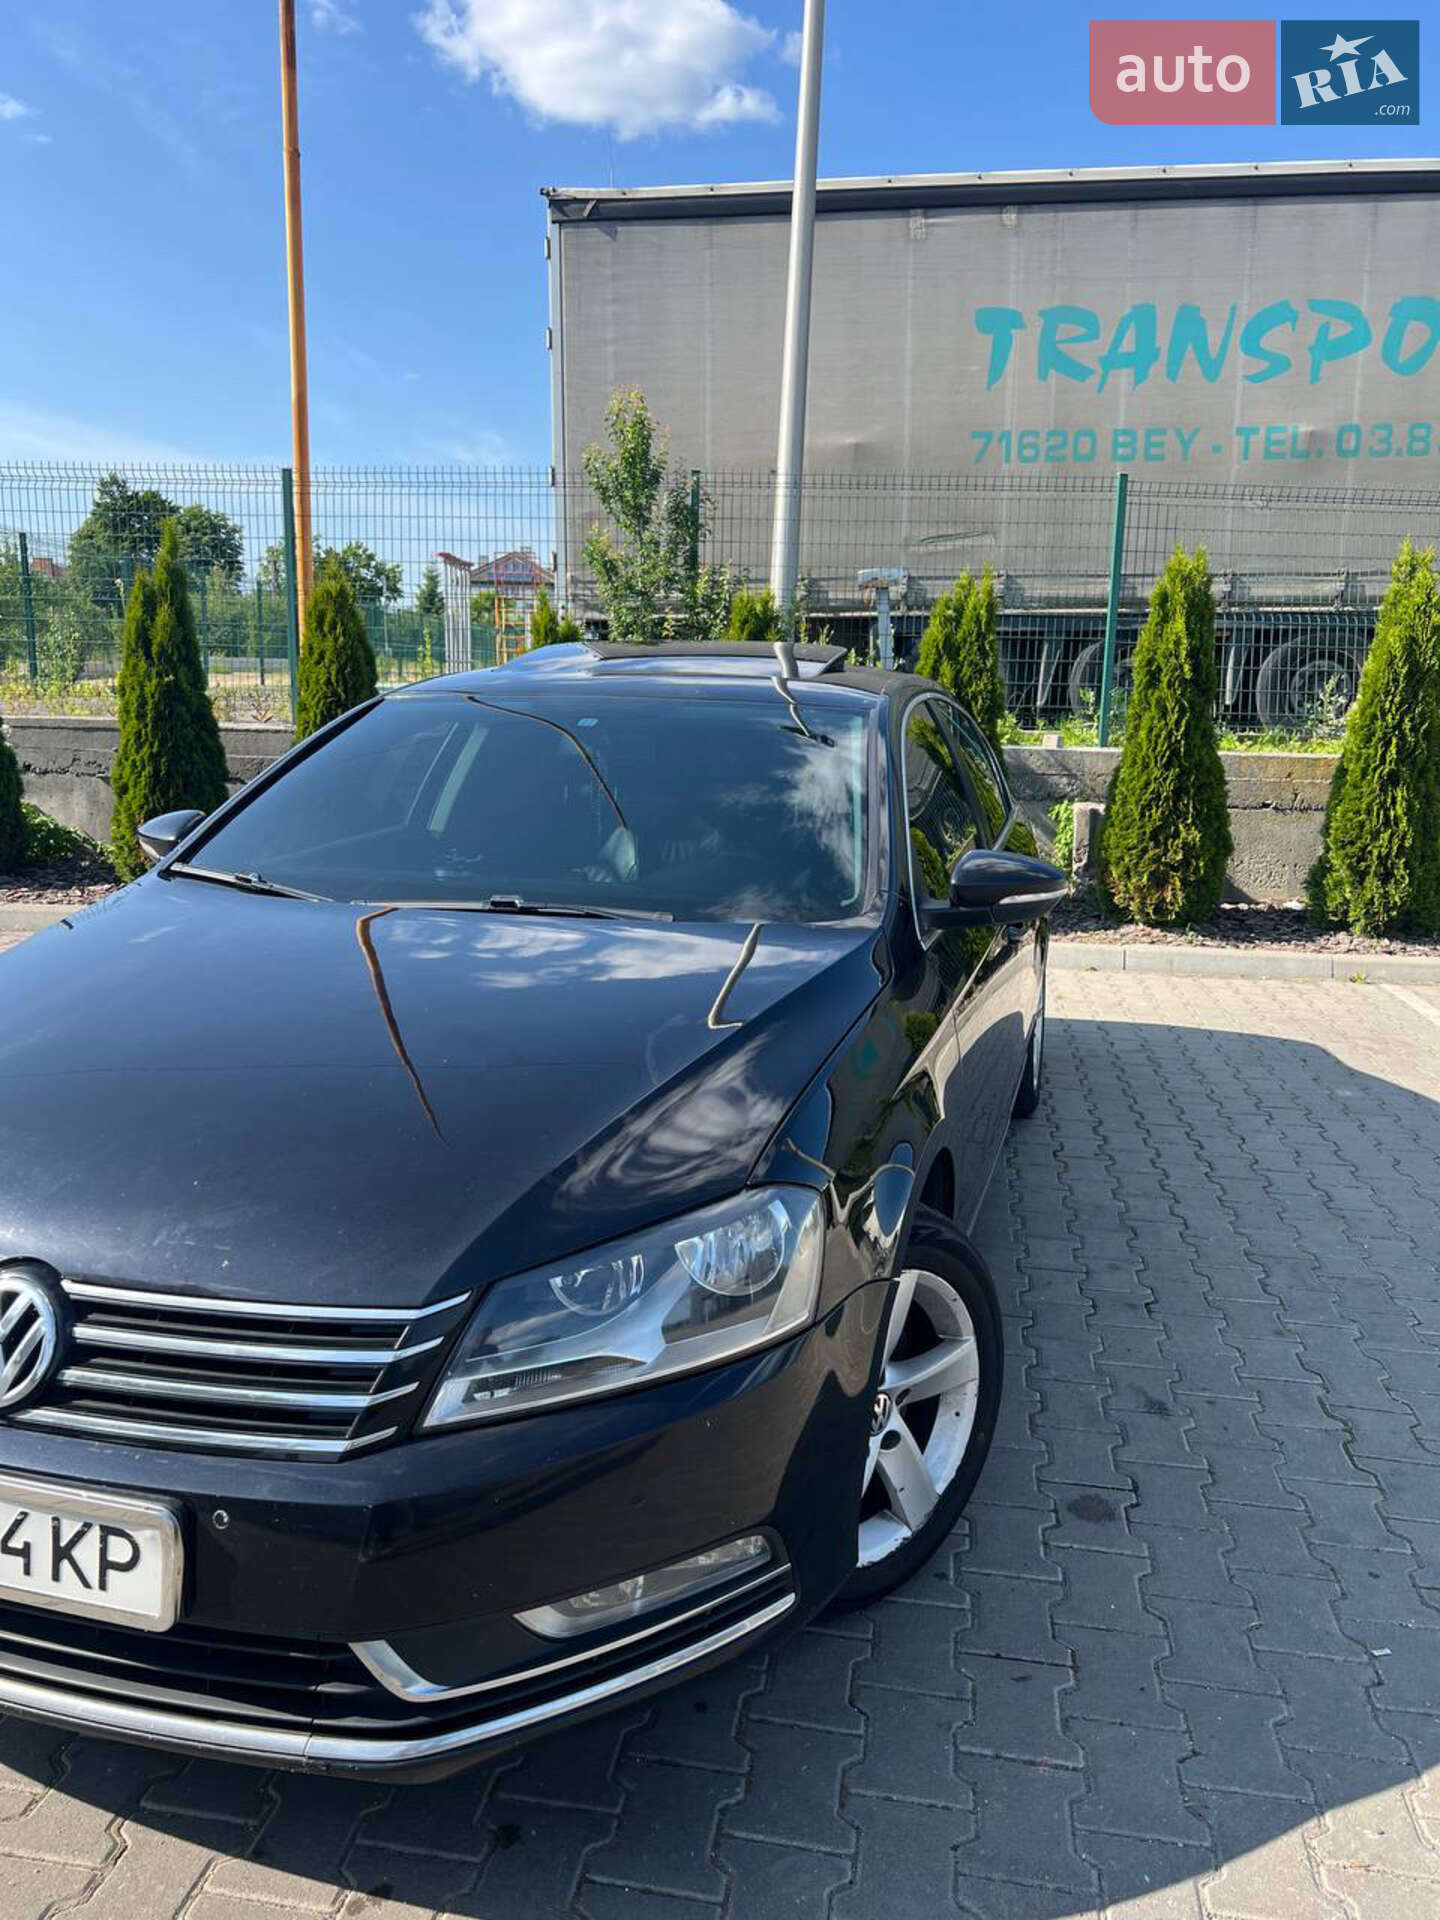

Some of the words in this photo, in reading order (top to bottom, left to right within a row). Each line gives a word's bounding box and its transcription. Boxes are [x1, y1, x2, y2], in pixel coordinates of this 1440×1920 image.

[970, 430, 1097, 464] 71620
[1112, 427, 1201, 462] BEY
[1236, 424, 1323, 460] TEL.
[1336, 421, 1440, 458] 03.8
